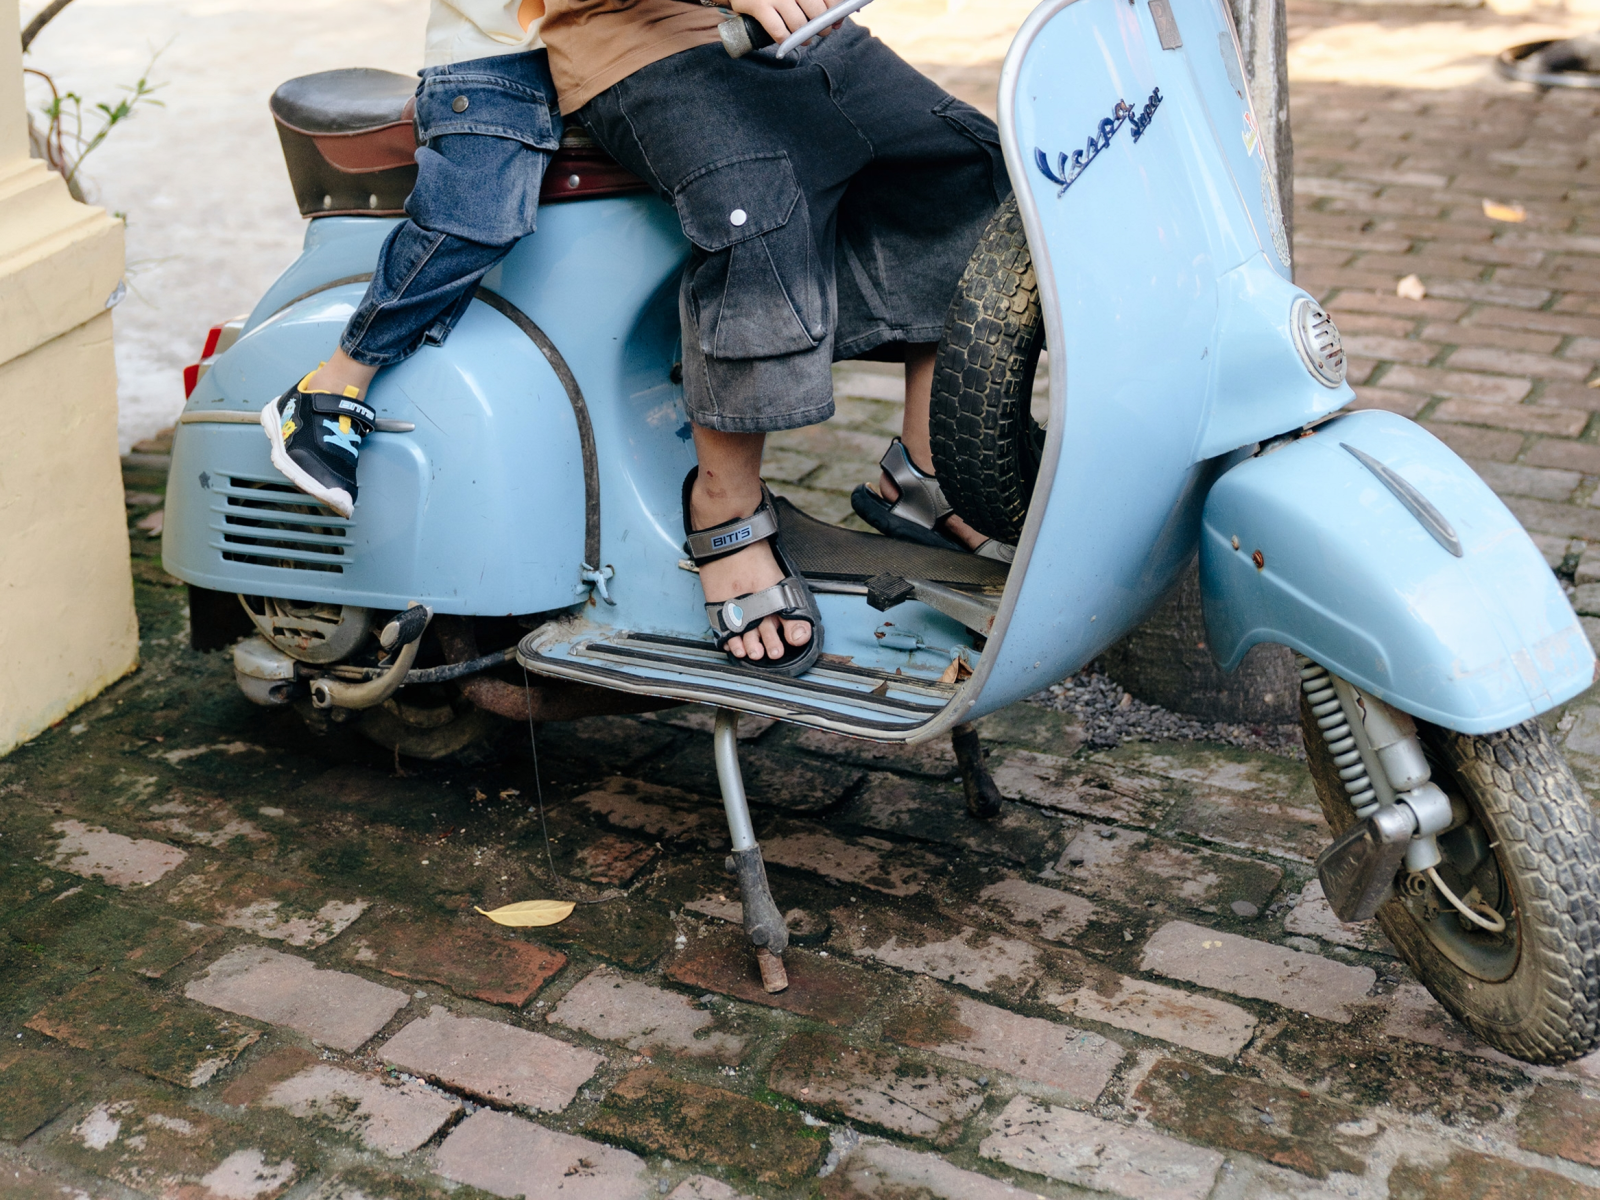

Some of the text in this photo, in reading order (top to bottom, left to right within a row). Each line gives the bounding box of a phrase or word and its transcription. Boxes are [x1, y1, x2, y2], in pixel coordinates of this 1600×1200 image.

[1127, 86, 1164, 144] Super
[1034, 99, 1135, 199] Vespa
[712, 527, 751, 548] BITI'S
